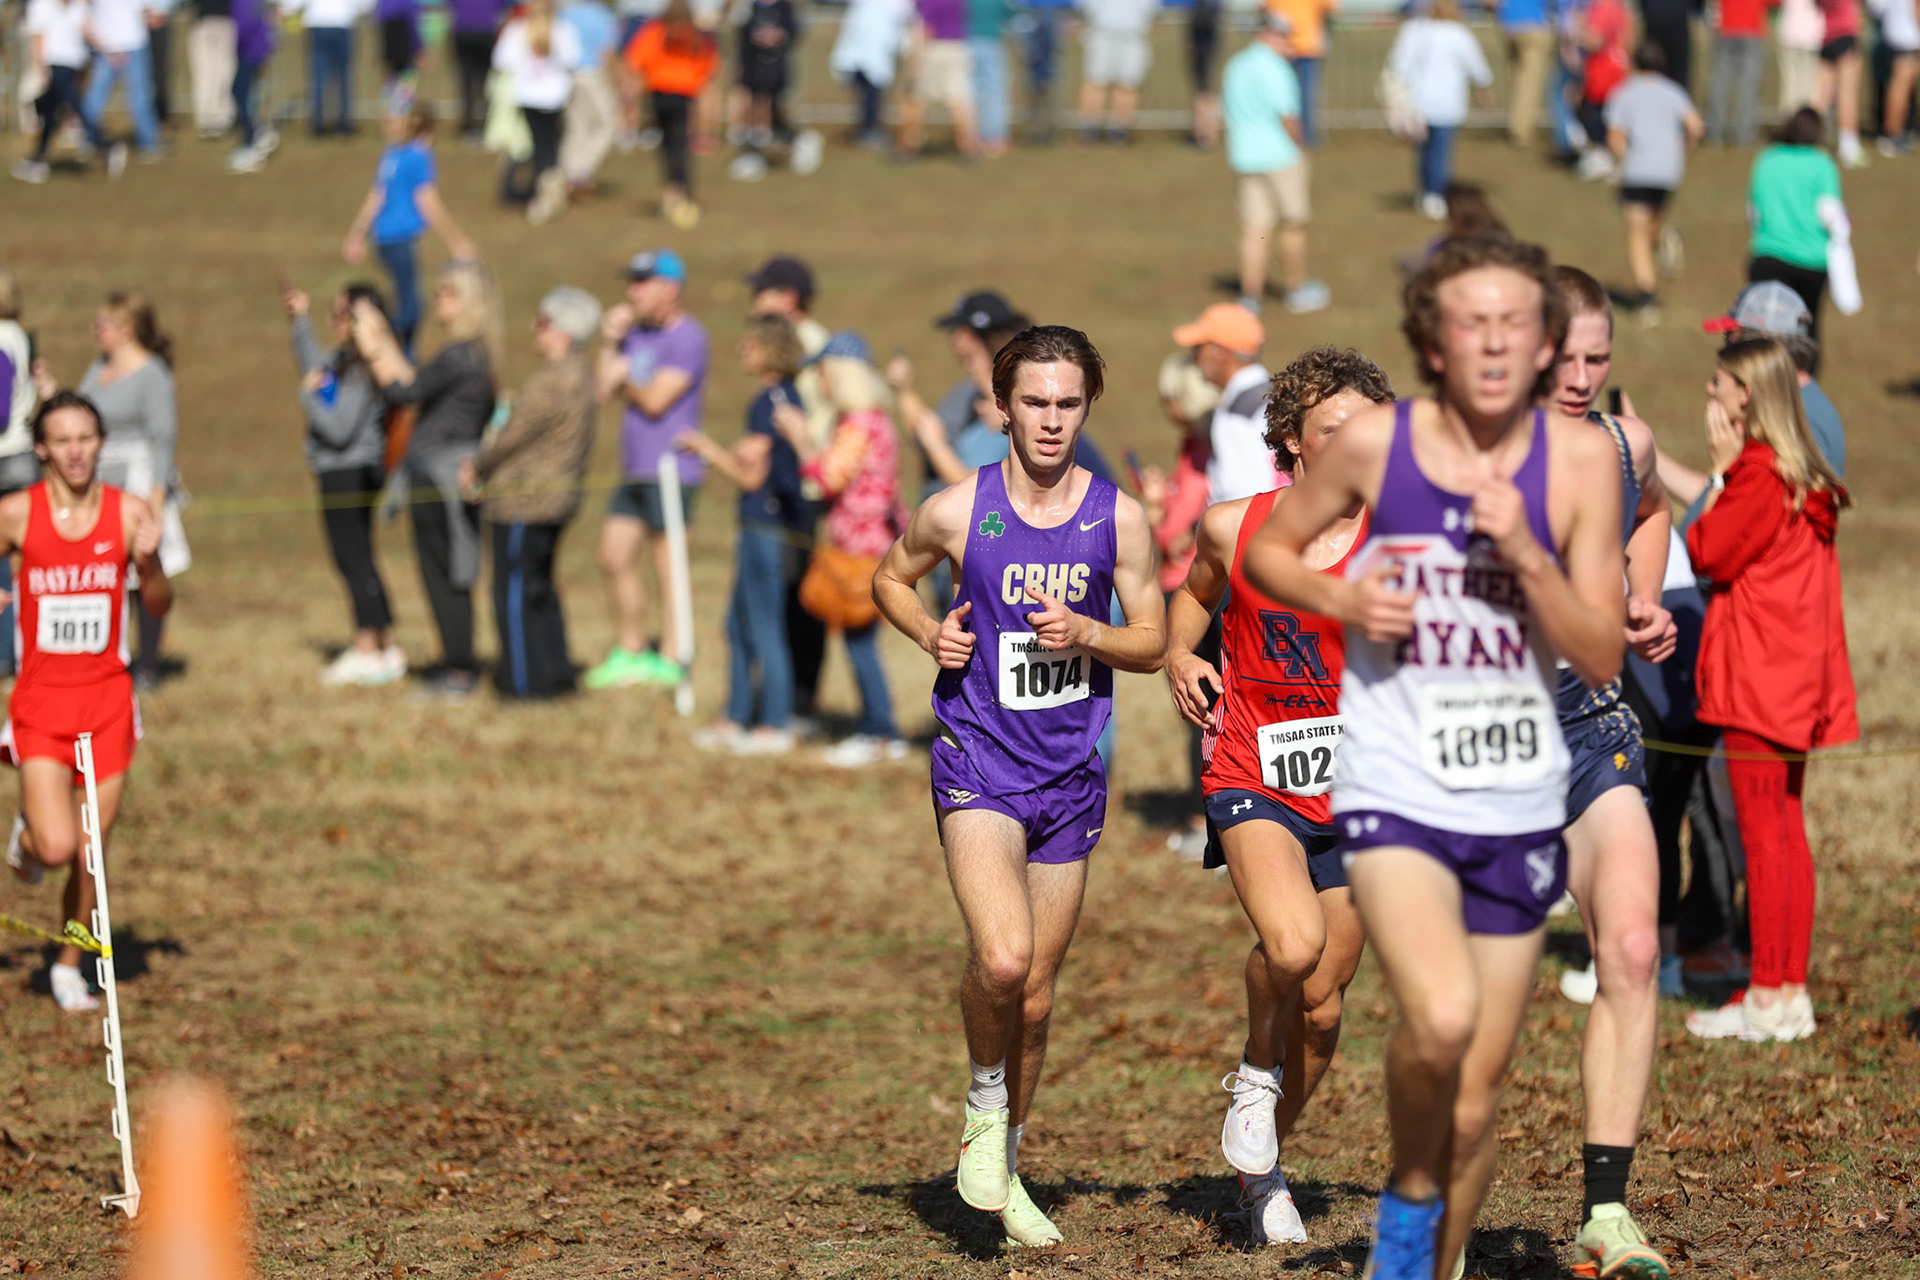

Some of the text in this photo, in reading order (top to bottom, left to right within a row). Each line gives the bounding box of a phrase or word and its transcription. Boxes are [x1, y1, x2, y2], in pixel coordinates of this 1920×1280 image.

[28, 562, 117, 595] BAYLOR
[1001, 563, 1090, 605] CBHS
[53, 621, 100, 641] 1011
[1258, 609, 1329, 681] BA
[1010, 655, 1083, 698] 1074
[1269, 729, 1305, 745] TMSAA
[1306, 725, 1336, 739] STATE
[1433, 718, 1538, 769] 1899
[1270, 746, 1342, 789] 102
